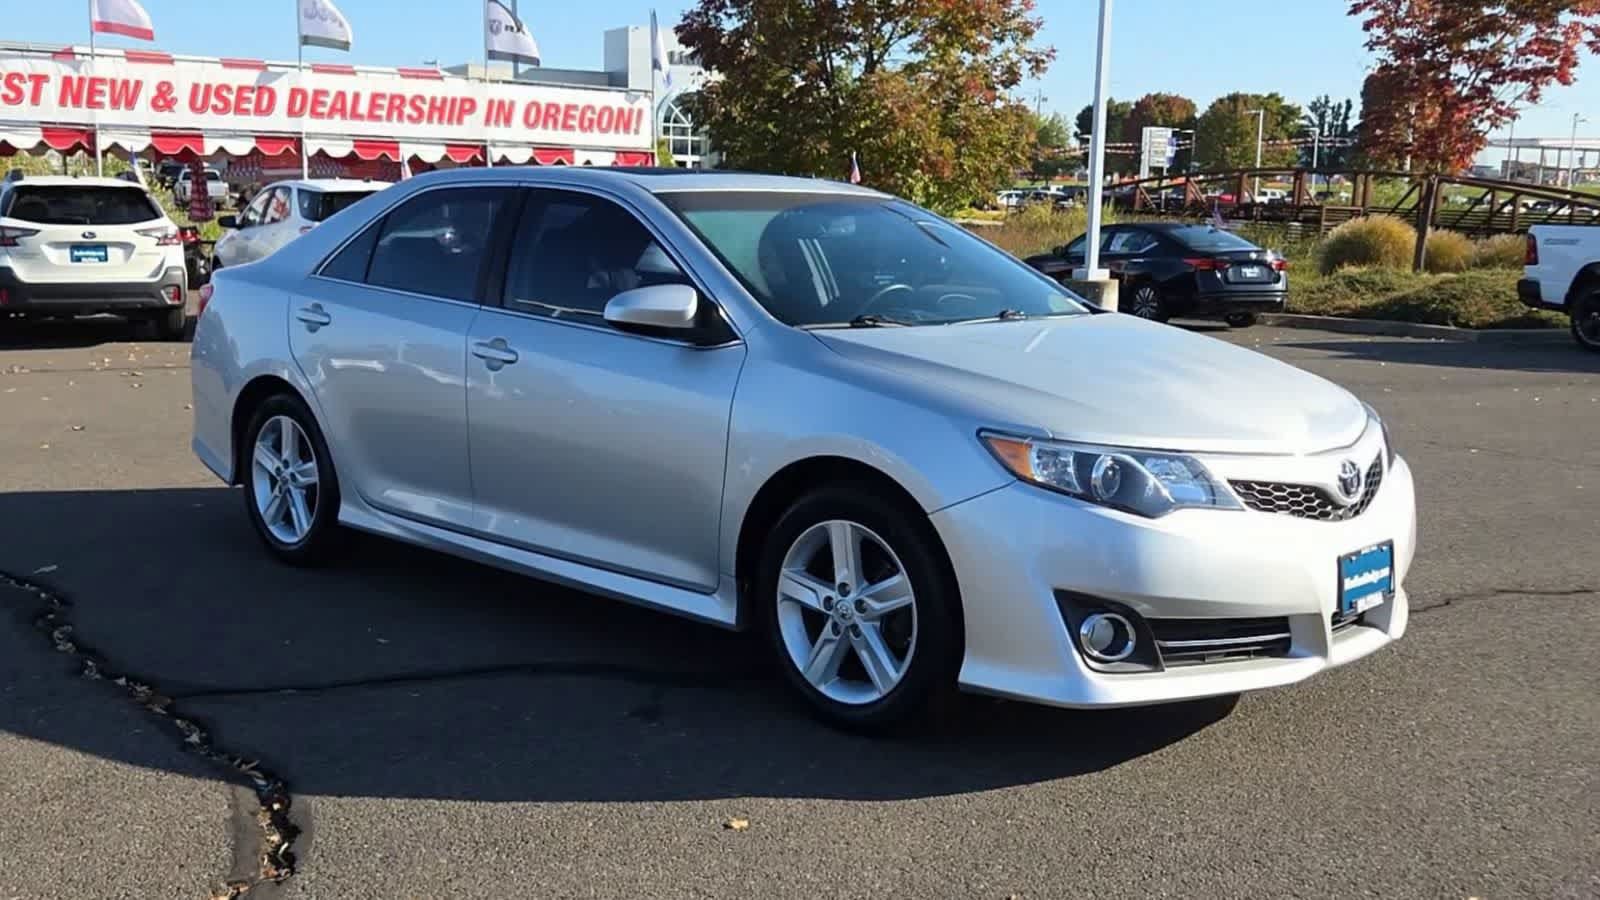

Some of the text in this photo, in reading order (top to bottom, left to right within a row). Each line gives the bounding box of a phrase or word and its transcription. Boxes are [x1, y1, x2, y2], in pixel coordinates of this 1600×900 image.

[0, 72, 644, 136] ST NEW & USED DEALERSHIP IN OREGON!
